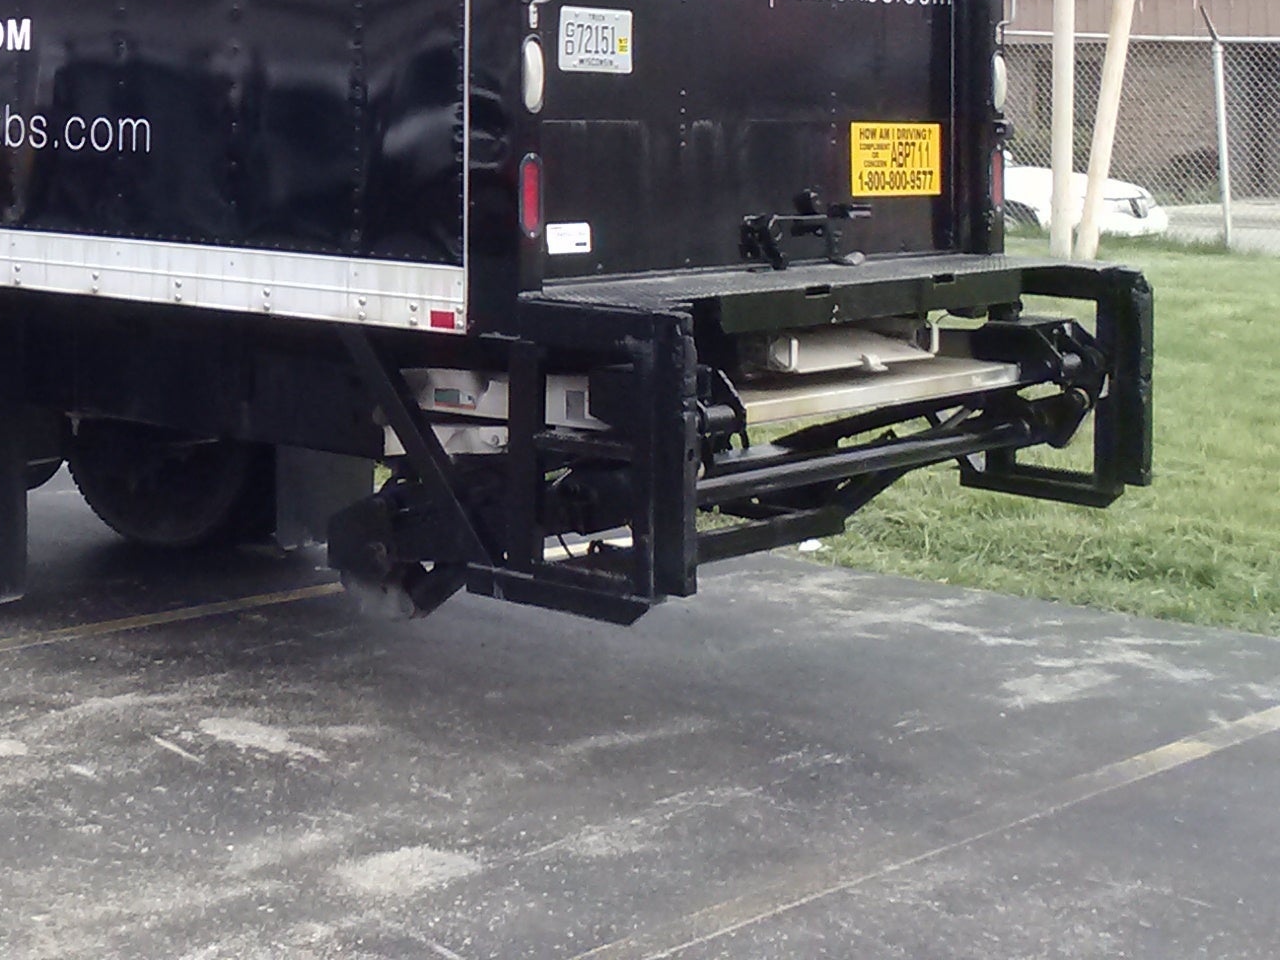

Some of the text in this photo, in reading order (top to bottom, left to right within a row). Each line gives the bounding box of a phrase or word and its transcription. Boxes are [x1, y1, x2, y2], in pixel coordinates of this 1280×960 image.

[577, 24, 616, 55] 72151
[860, 128, 877, 140] HOW
[880, 128, 890, 140] AM
[859, 170, 933, 191] 1-800-800-9577
